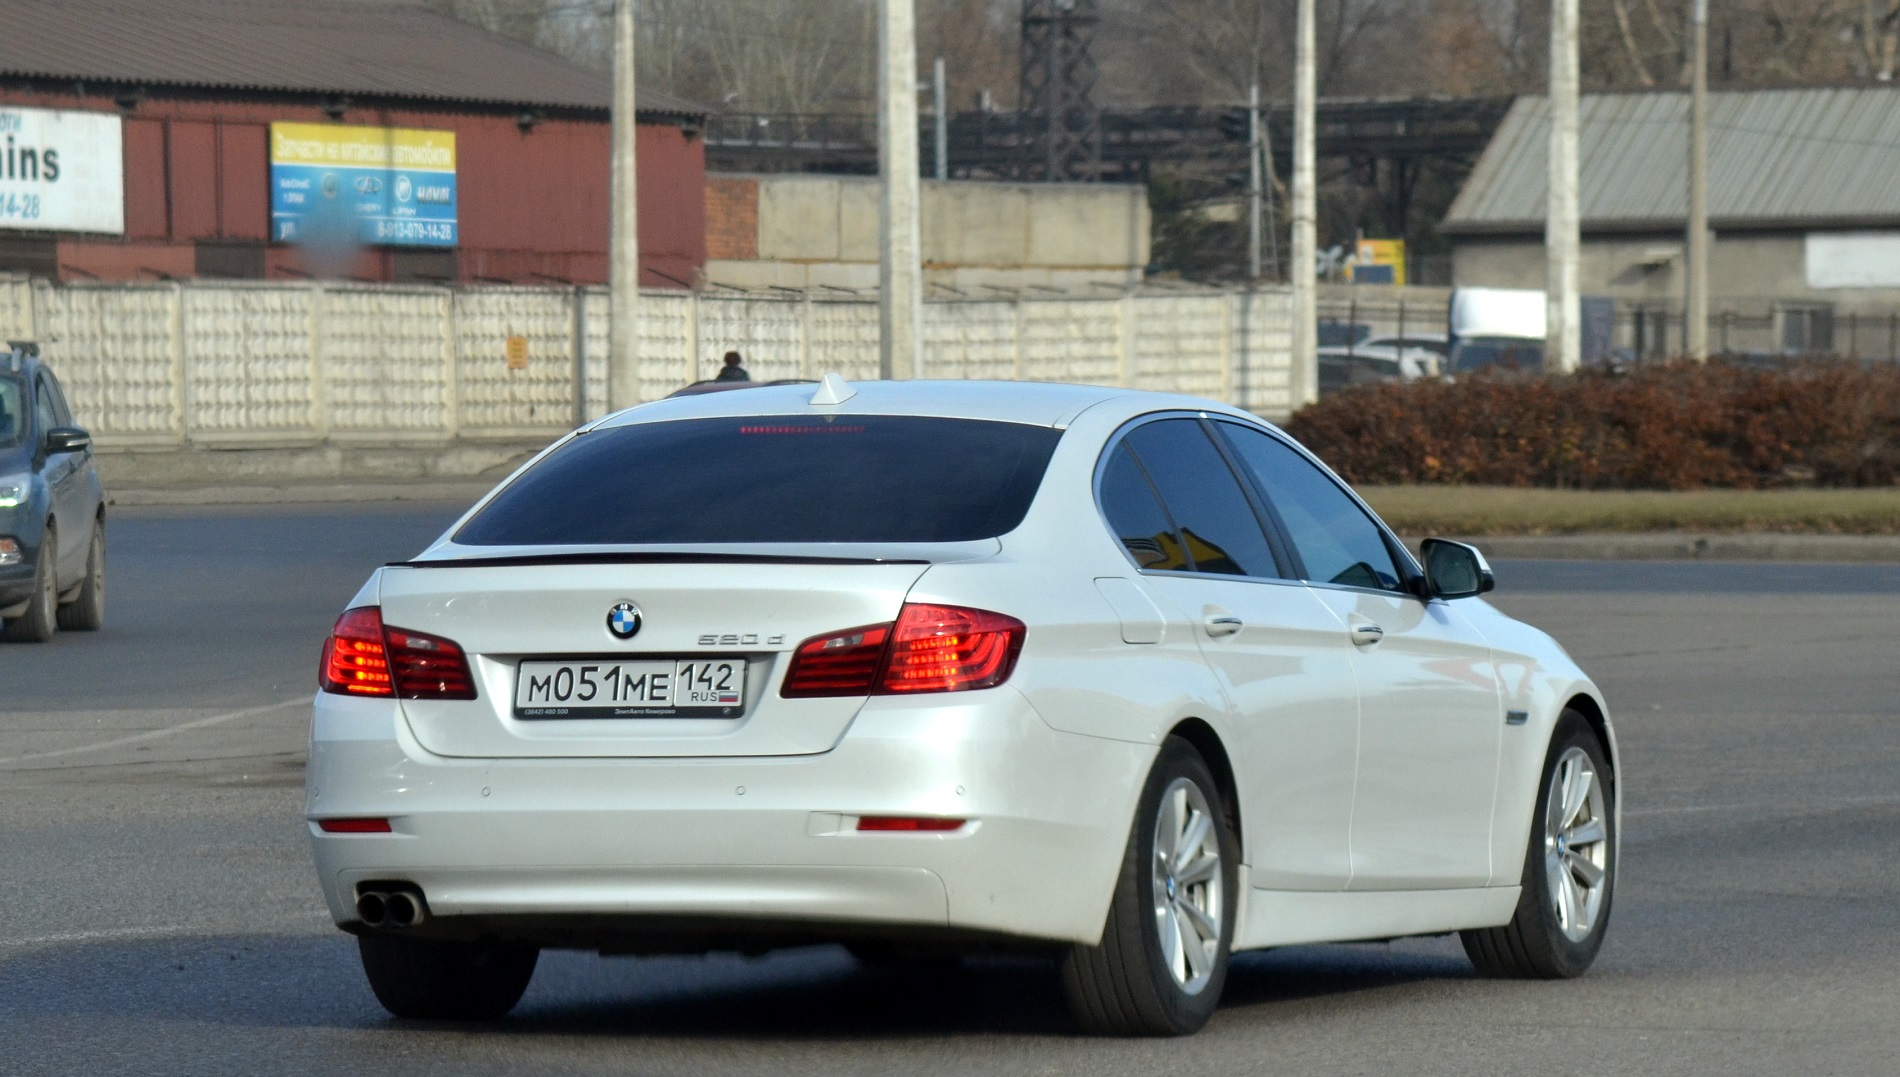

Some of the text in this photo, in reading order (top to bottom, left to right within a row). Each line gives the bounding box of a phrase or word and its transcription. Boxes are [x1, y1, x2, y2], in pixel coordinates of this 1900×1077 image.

[0, 134, 60, 182] ins
[377, 221, 452, 240] 8-913-079-14-28
[680, 663, 734, 691] 142
[691, 691, 718, 702] RUS
